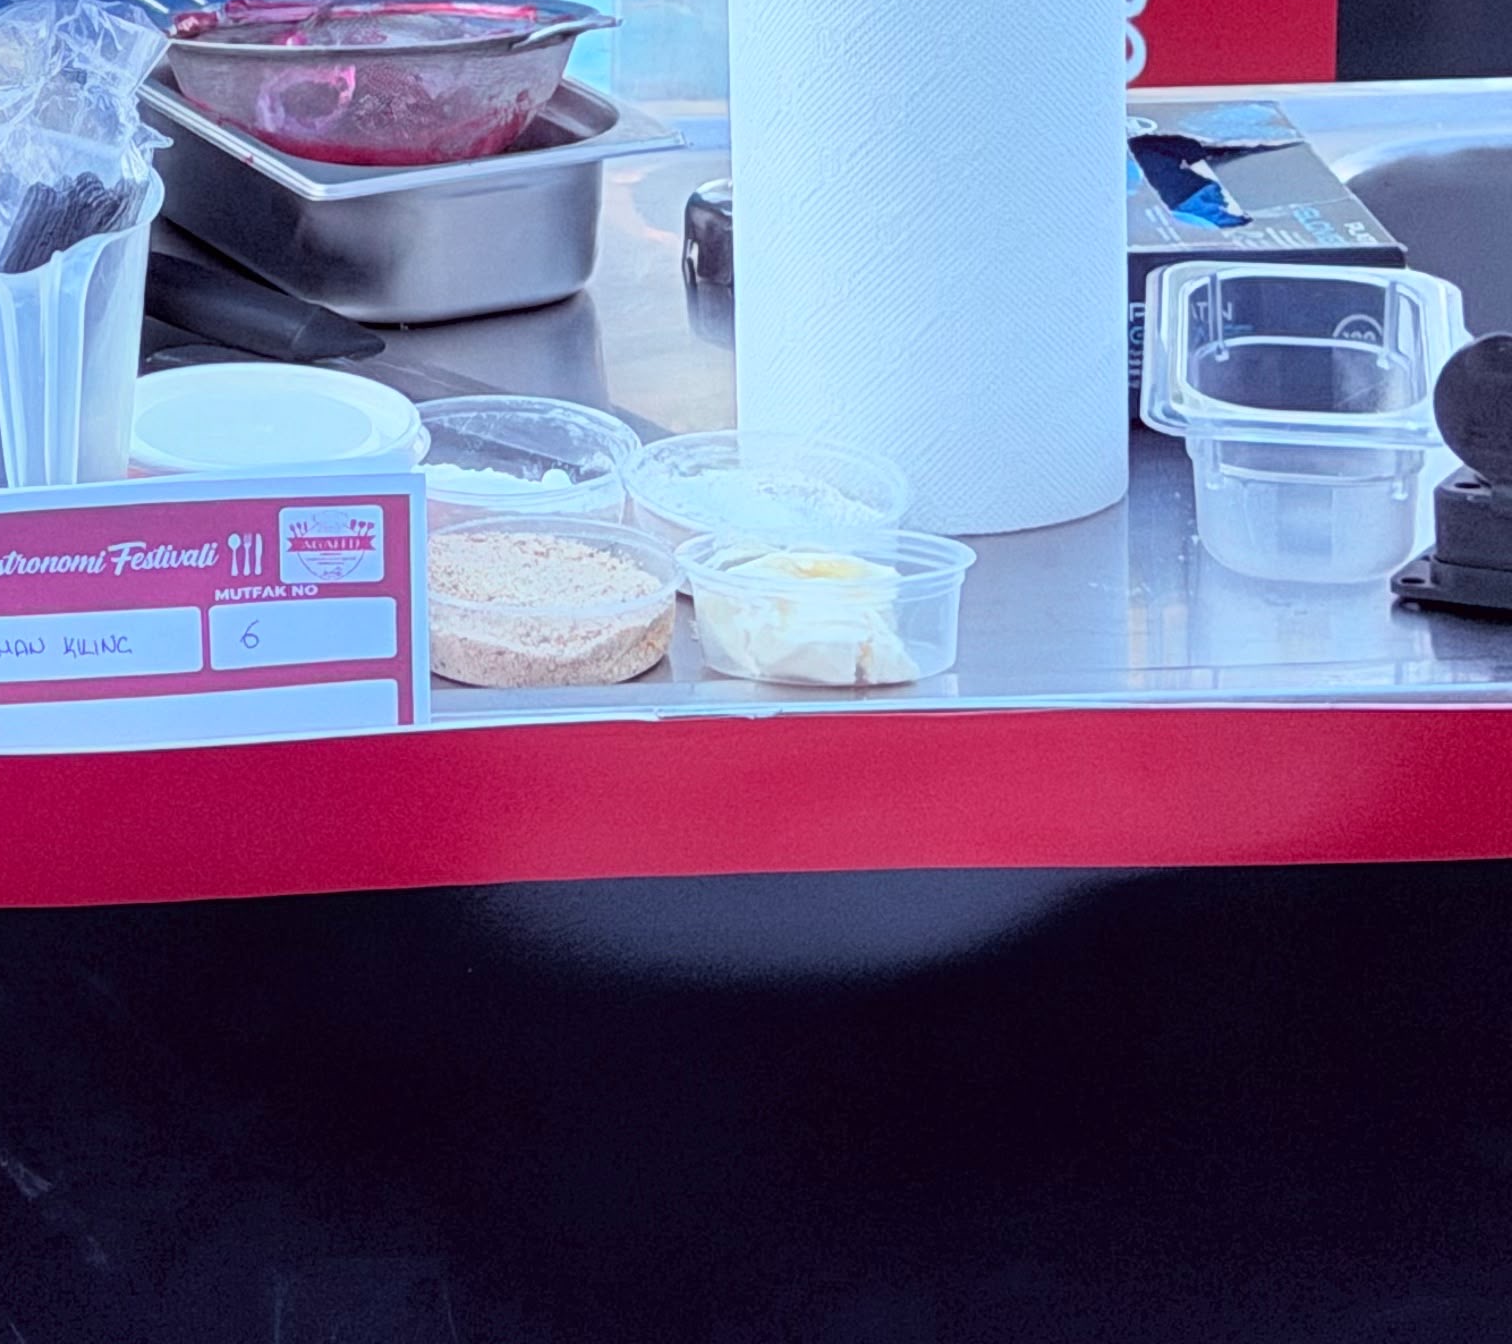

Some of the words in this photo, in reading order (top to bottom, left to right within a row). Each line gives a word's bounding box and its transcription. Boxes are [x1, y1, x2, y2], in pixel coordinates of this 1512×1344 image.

[107, 540, 220, 576] Festivali
[214, 586, 288, 602] MUTFAK
[291, 584, 319, 597] NO
[239, 618, 260, 650] 6
